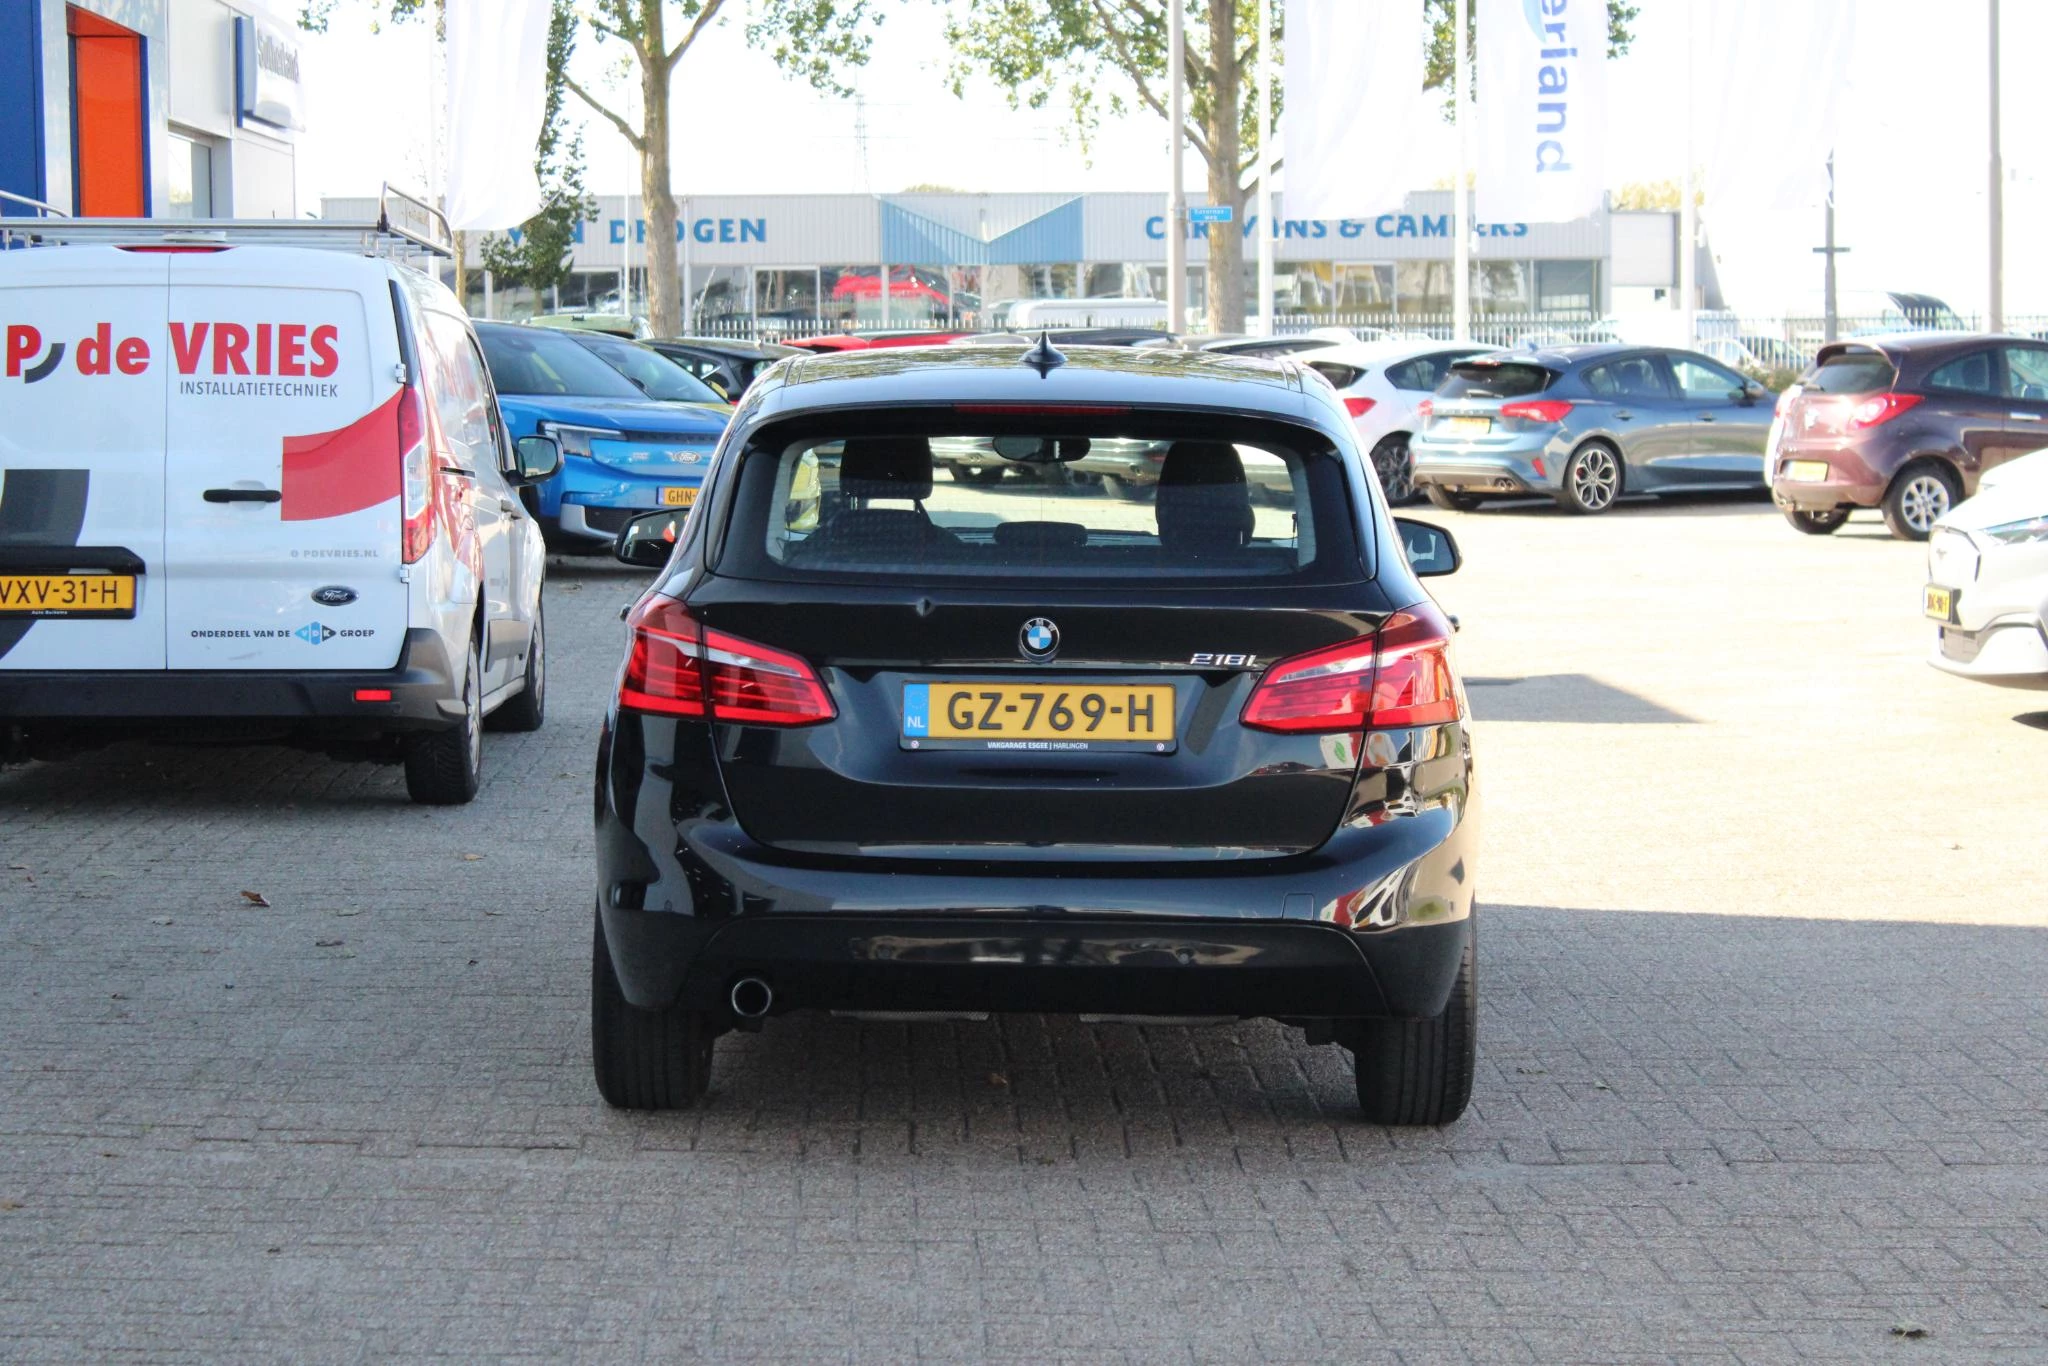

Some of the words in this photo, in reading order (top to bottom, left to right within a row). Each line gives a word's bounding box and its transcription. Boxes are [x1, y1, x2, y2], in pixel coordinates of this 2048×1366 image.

[1145, 215, 1327, 239] CRVNS
[1375, 213, 1528, 238] CAMRS
[76, 322, 151, 376] de
[168, 322, 339, 378] VRIES
[180, 380, 338, 397] INSTALLATIETECHNIEK
[667, 489, 698, 504] GHN-
[303, 549, 379, 558] PDEVRIES.NL
[0, 580, 117, 604] VXV-31-H
[321, 588, 349, 602] Ford
[1024, 617, 1057, 632] BMW
[190, 629, 251, 638] ONDERDEEL
[253, 629, 274, 638] VAN
[277, 629, 290, 638] DE
[340, 629, 375, 638] GROEP
[906, 715, 926, 729] NL
[946, 690, 1155, 733] GZ-769-H
[987, 741, 1027, 749] VAKGARAGE
[1053, 742, 1088, 750] HARLINGEN
